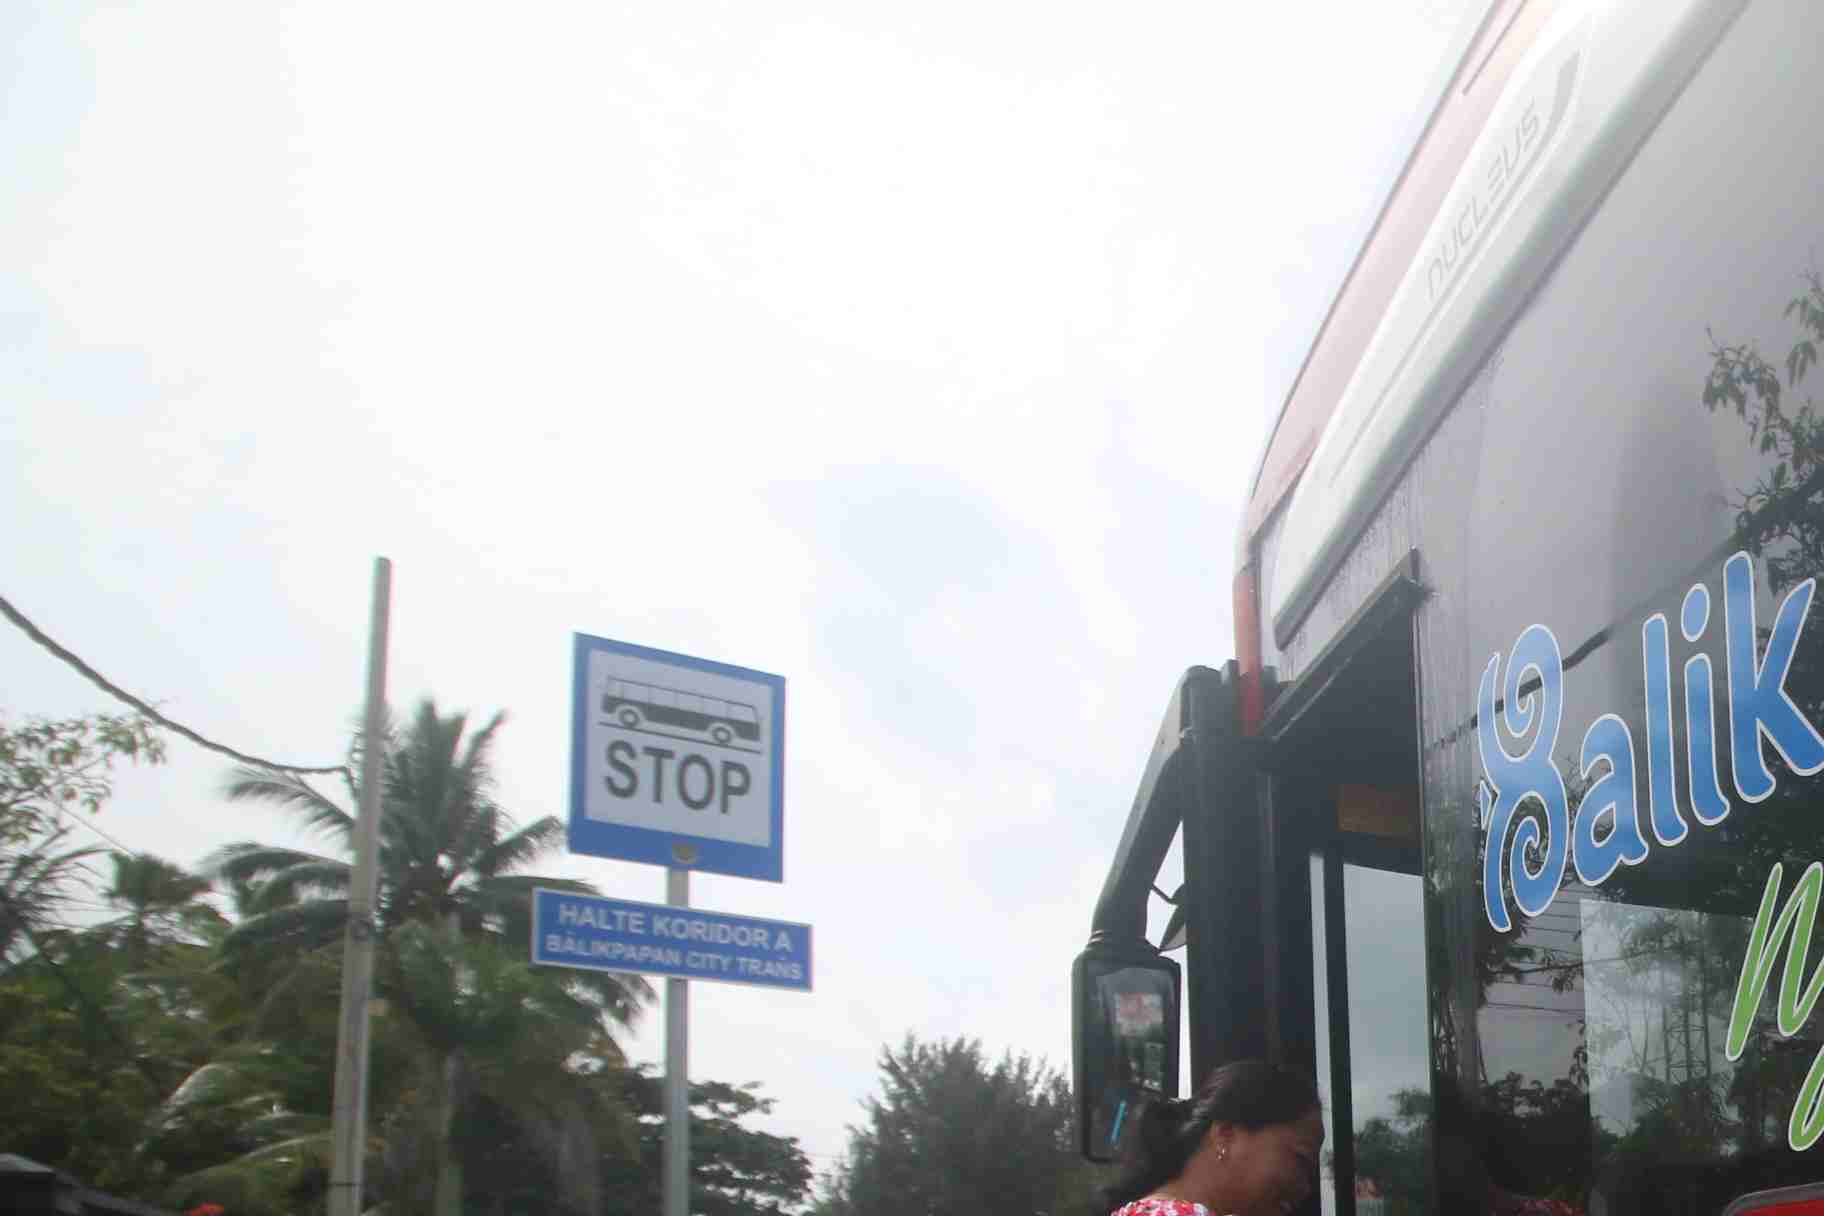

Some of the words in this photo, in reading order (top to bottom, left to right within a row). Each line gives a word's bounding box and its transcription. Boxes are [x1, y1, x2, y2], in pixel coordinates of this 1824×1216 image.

[605, 740, 751, 814] STOP
[558, 902, 645, 934] HALTE
[651, 912, 769, 948] KORIDOR
[773, 926, 794, 953] A
[545, 932, 682, 967] BALIKPAPAN
[686, 950, 731, 972] CITY
[735, 956, 803, 980] TRANS
